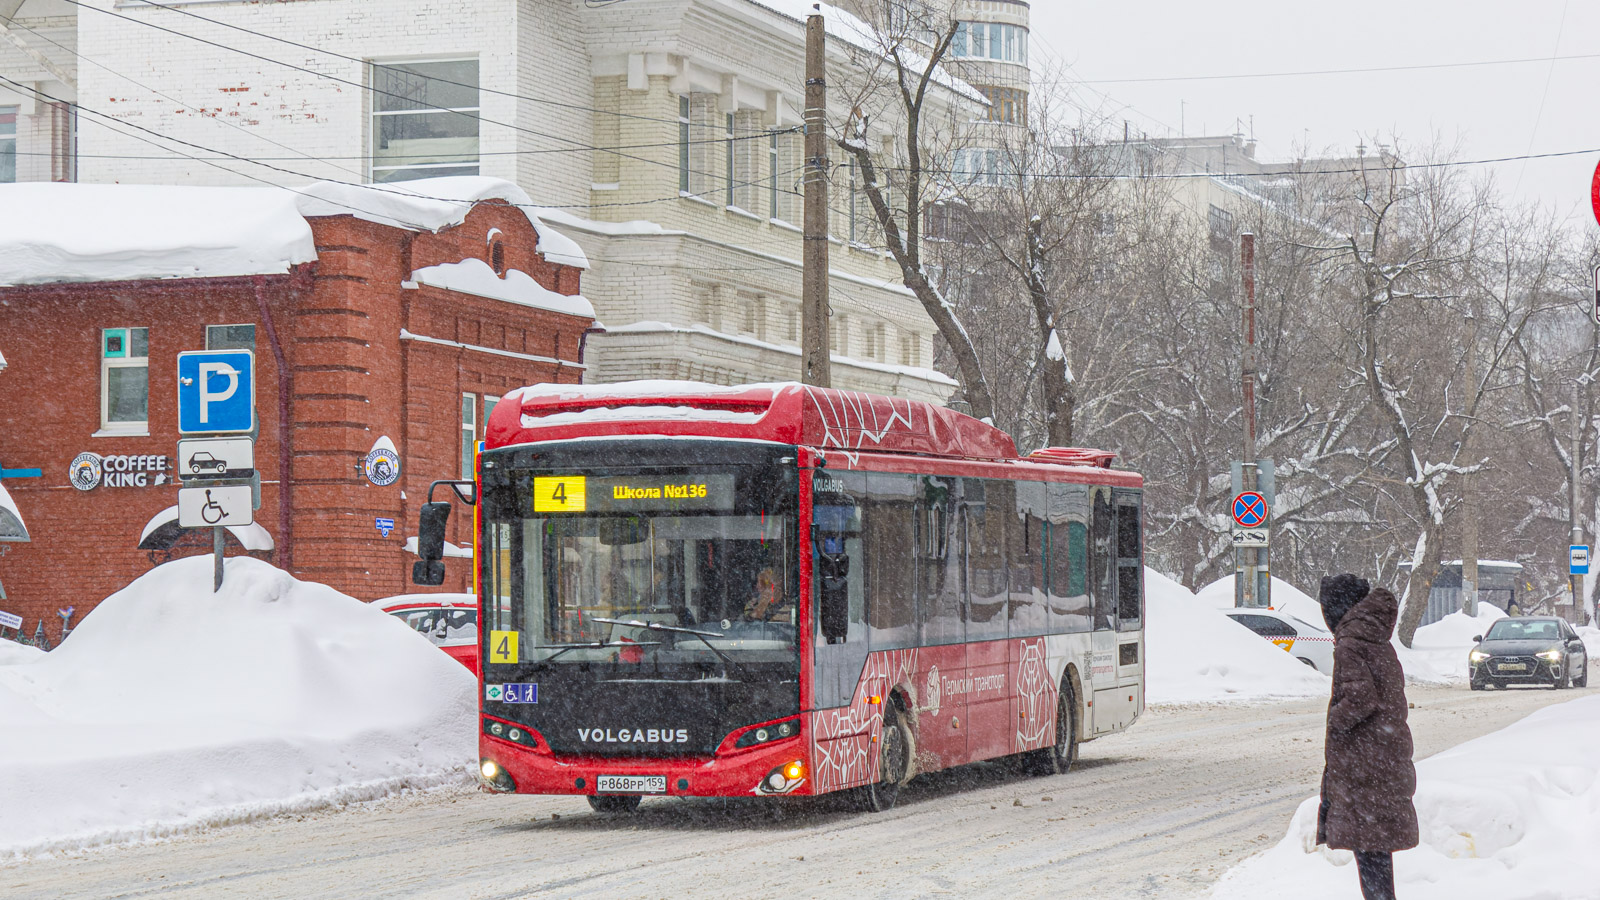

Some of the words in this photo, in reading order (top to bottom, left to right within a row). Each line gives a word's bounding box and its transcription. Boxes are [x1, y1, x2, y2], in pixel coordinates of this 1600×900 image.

[199, 362, 239, 423] P
[103, 456, 166, 472] COFFEE
[103, 472, 147, 487] KING
[813, 478, 843, 492] VOLGABUS
[552, 482, 567, 504] 4
[613, 485, 661, 499] Школа
[664, 484, 708, 498] №136
[496, 635, 510, 660] 4
[941, 673, 974, 701] Пермский
[974, 674, 1005, 697] транспорт
[577, 728, 689, 743] VOLGABUS
